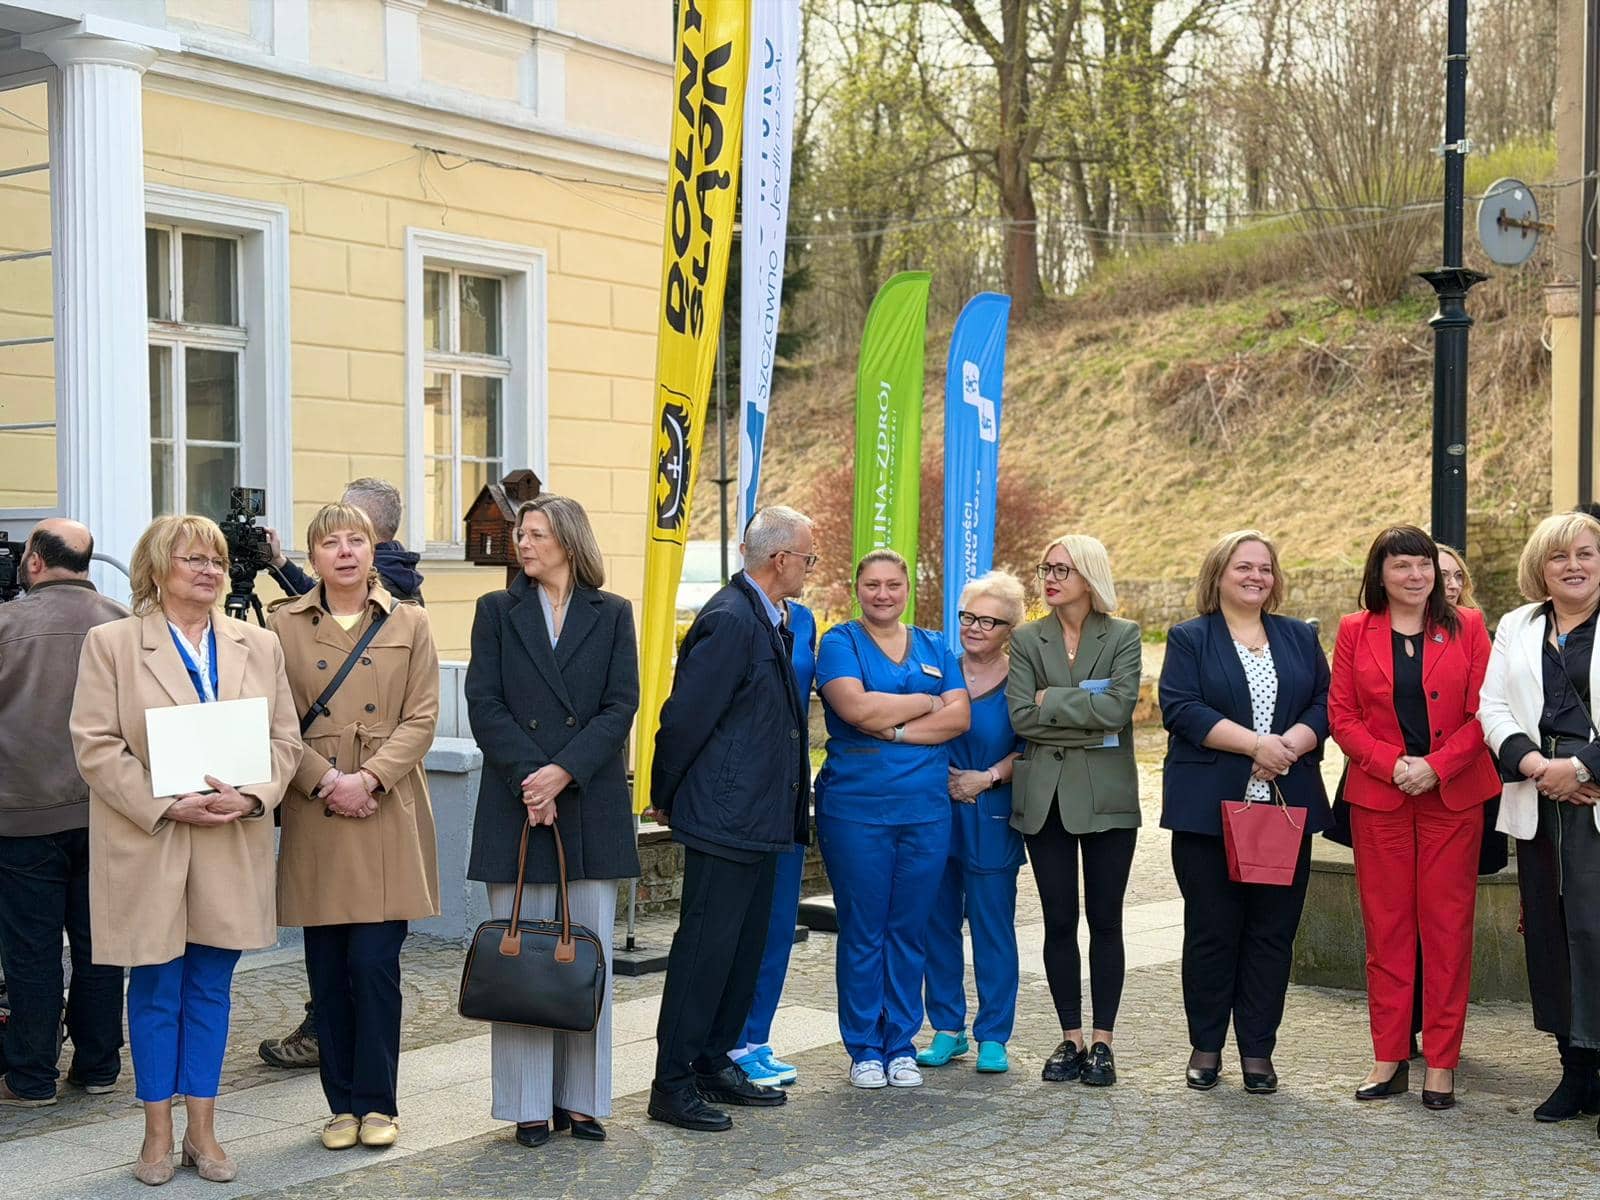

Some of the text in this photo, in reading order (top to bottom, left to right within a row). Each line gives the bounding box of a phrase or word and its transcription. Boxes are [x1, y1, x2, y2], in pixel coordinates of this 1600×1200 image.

[757, 250, 780, 399] Szczawno
[873, 380, 892, 547] LINA-ZDRÓJ
[962, 502, 973, 584] YWNOŚCI
